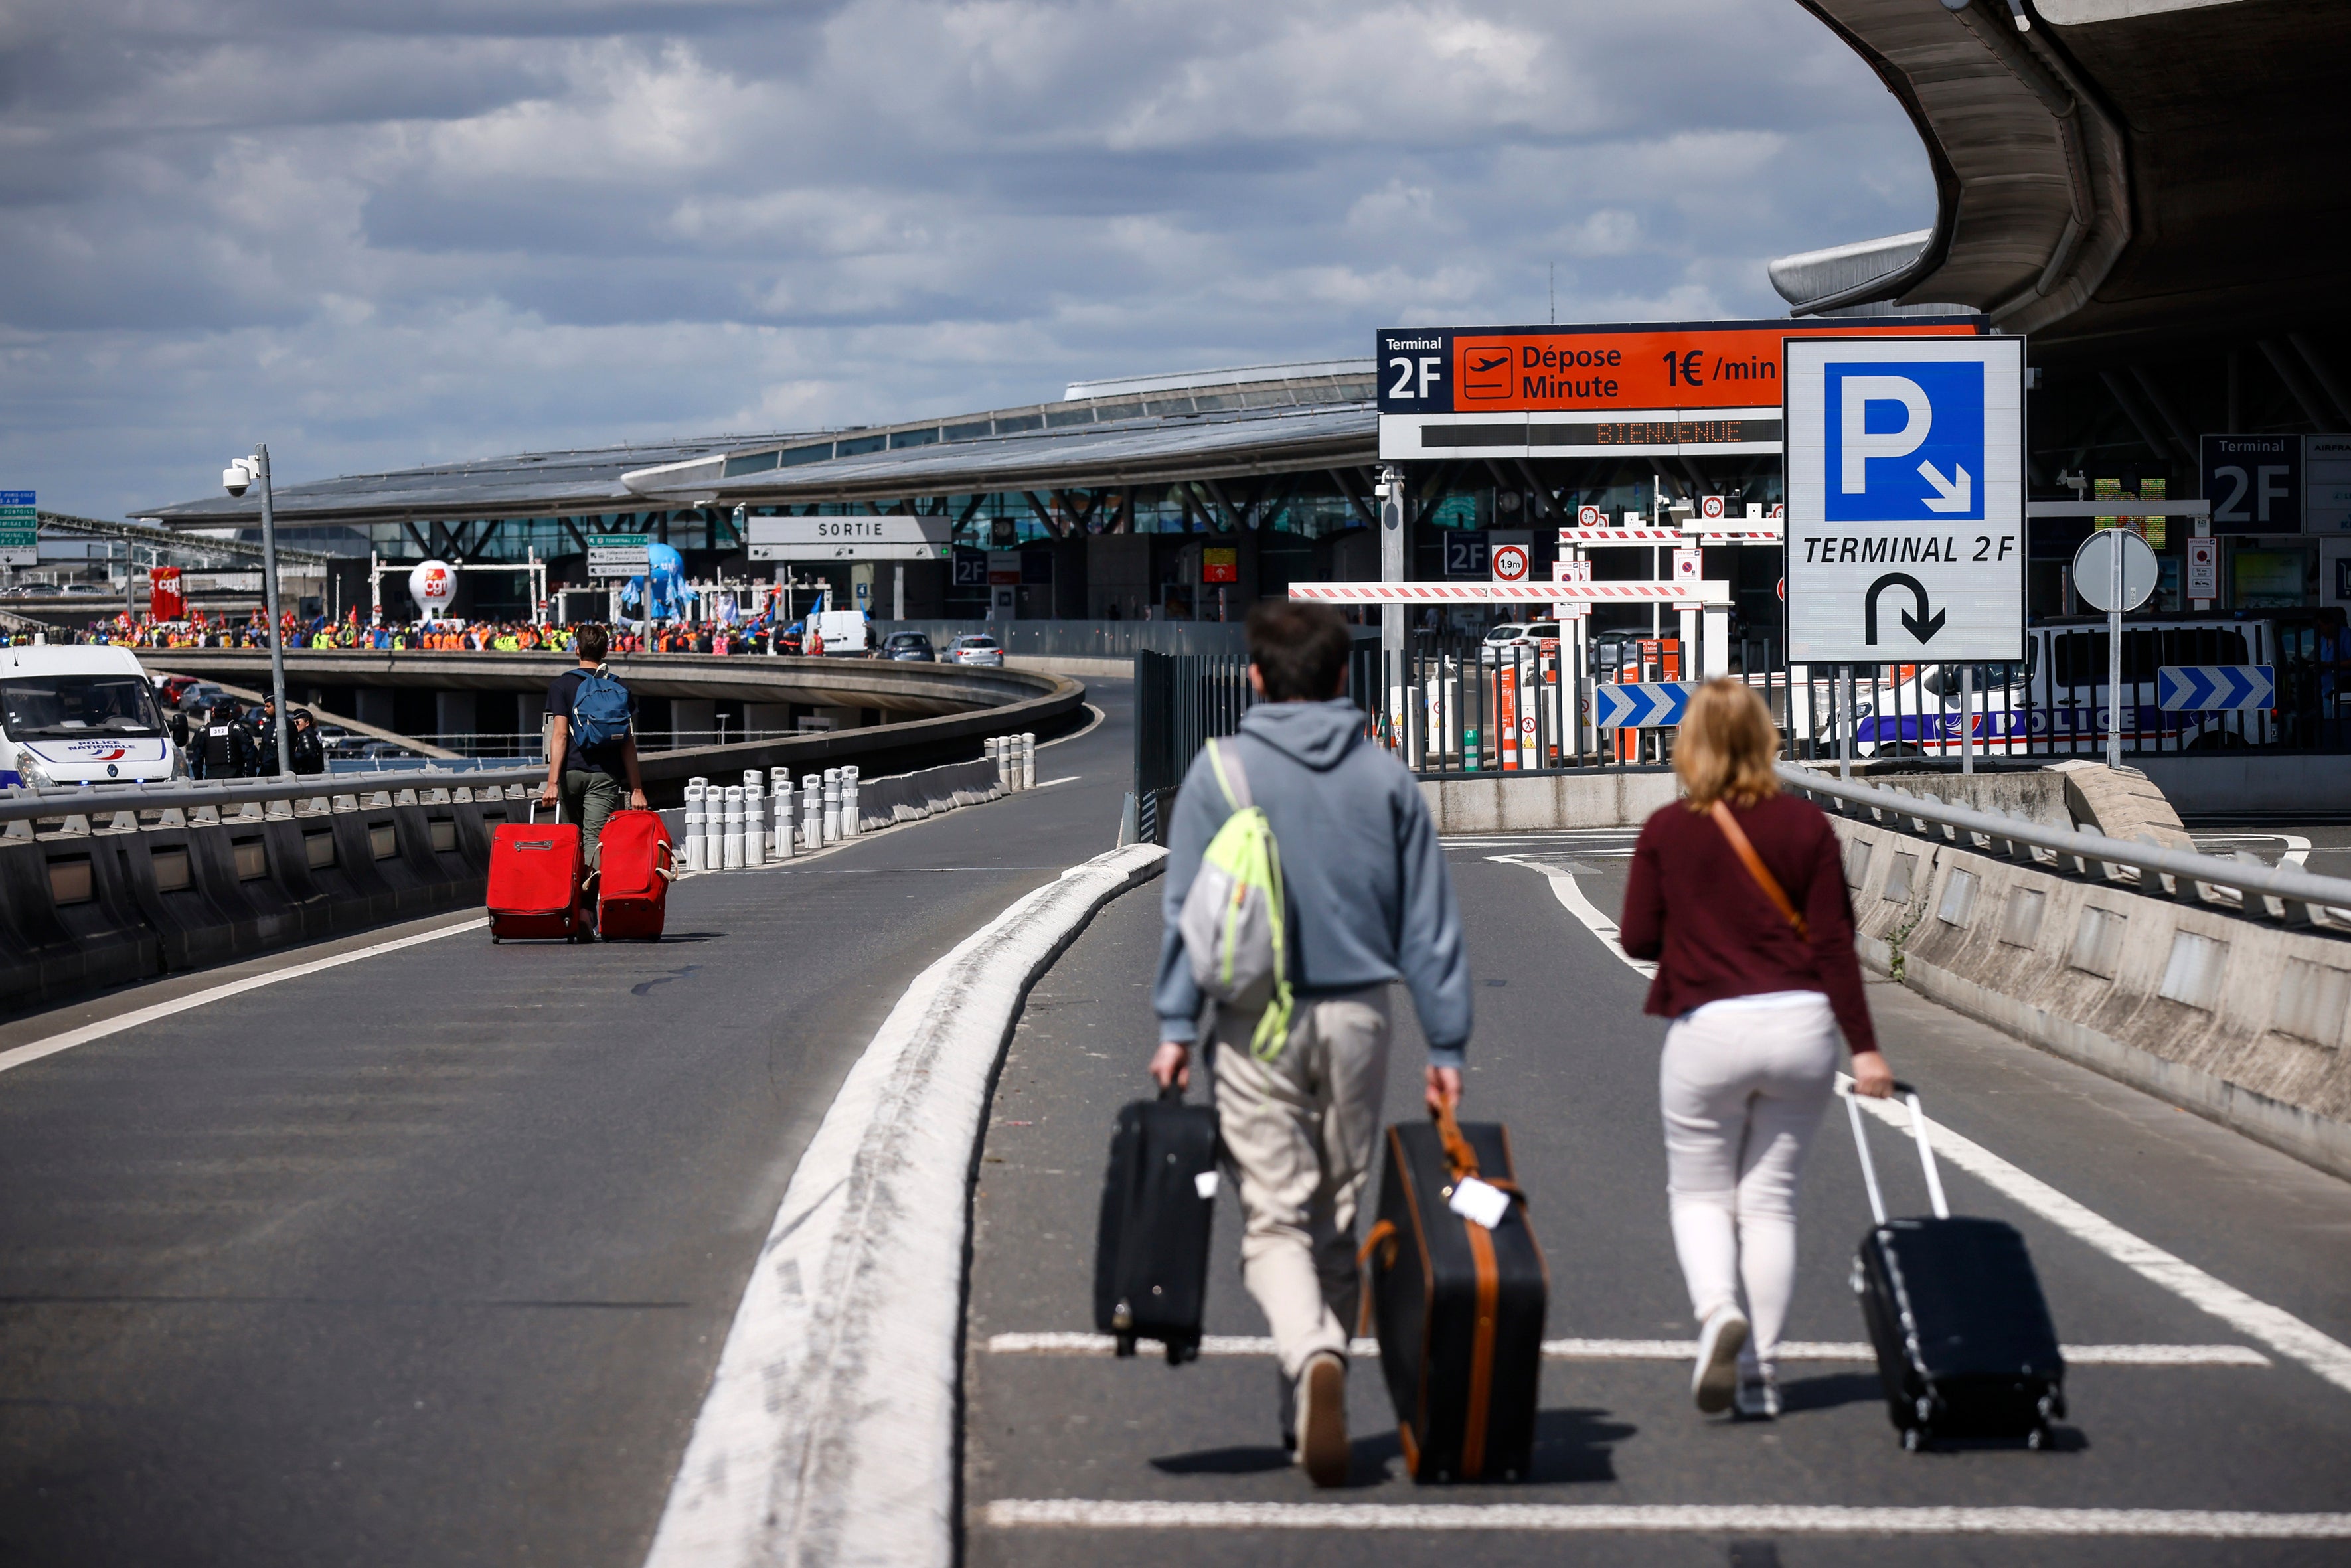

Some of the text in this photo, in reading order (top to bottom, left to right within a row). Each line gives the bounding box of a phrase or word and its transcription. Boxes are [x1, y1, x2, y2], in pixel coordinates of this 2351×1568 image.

[1386, 337, 1442, 351] Terminal
[1522, 344, 1621, 374] Dépose
[1662, 349, 1776, 388] 1€ /min
[1388, 357, 1441, 399] 2F
[1522, 375, 1619, 399] Minute
[1597, 421, 1742, 444] BIENVENUE
[1841, 376, 1933, 495] P
[2219, 439, 2285, 452] Terminal
[2214, 465, 2289, 522] 2F
[818, 523, 883, 536] SORTIE
[1451, 544, 1484, 569] 2F
[1803, 537, 1958, 563] TERMINAL
[958, 560, 984, 582] 2F
[158, 576, 180, 593] cgt
[425, 576, 447, 595] cgt
[1996, 708, 2135, 734] POLICE
